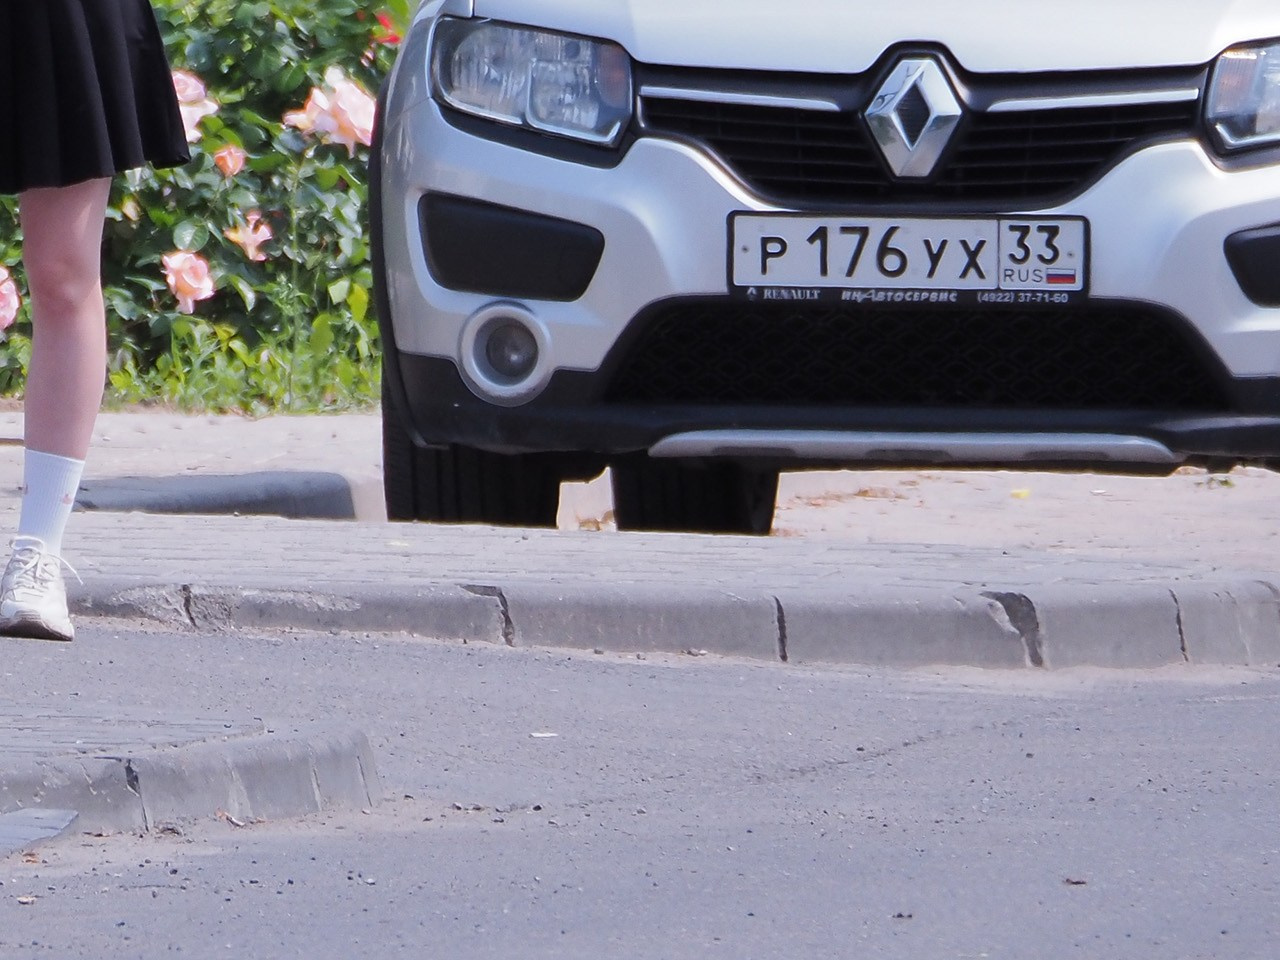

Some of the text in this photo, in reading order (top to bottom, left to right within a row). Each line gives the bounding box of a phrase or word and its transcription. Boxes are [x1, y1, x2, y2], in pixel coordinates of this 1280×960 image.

[1008, 224, 1061, 265] 33
[1003, 268, 1043, 283] RUS
[763, 289, 821, 300] RENAULT
